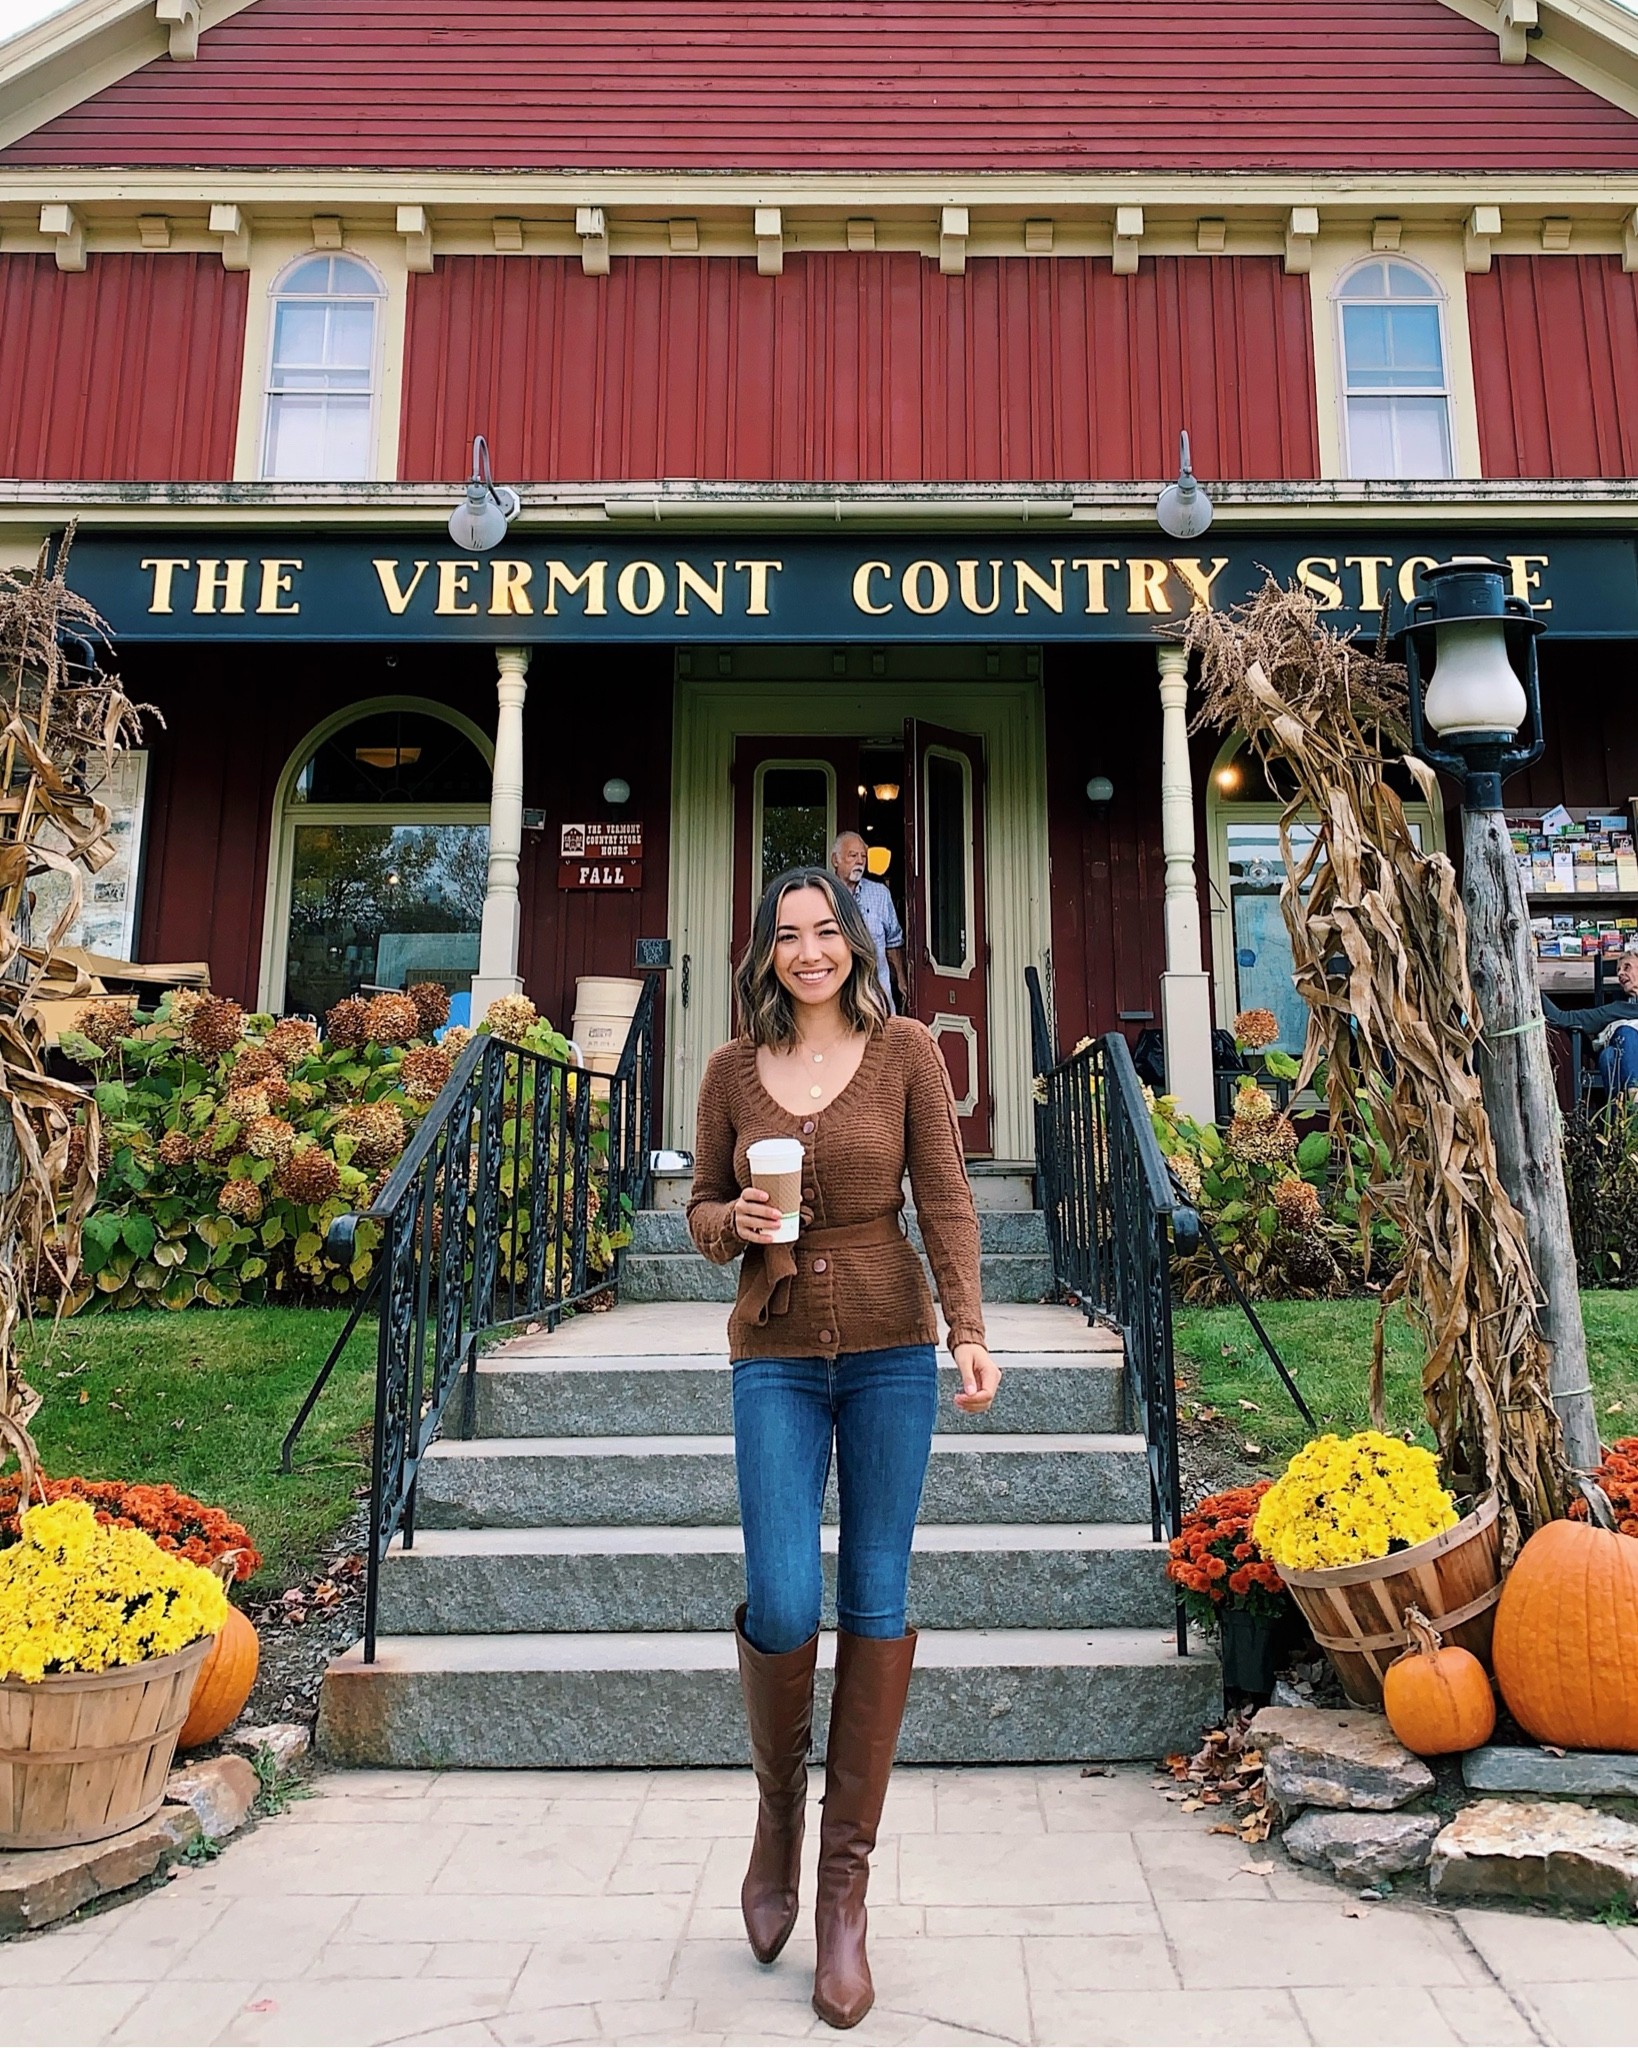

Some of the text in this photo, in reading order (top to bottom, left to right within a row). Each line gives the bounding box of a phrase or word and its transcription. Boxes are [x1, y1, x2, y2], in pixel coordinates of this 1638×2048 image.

[140, 555, 1553, 616] THE VERMONT COUNTRY STOE
[587, 824, 641, 835] THE VERMONT
[586, 835, 642, 846] COUNTRY STORE
[601, 846, 629, 856] HOURS
[579, 866, 624, 885] FALL
